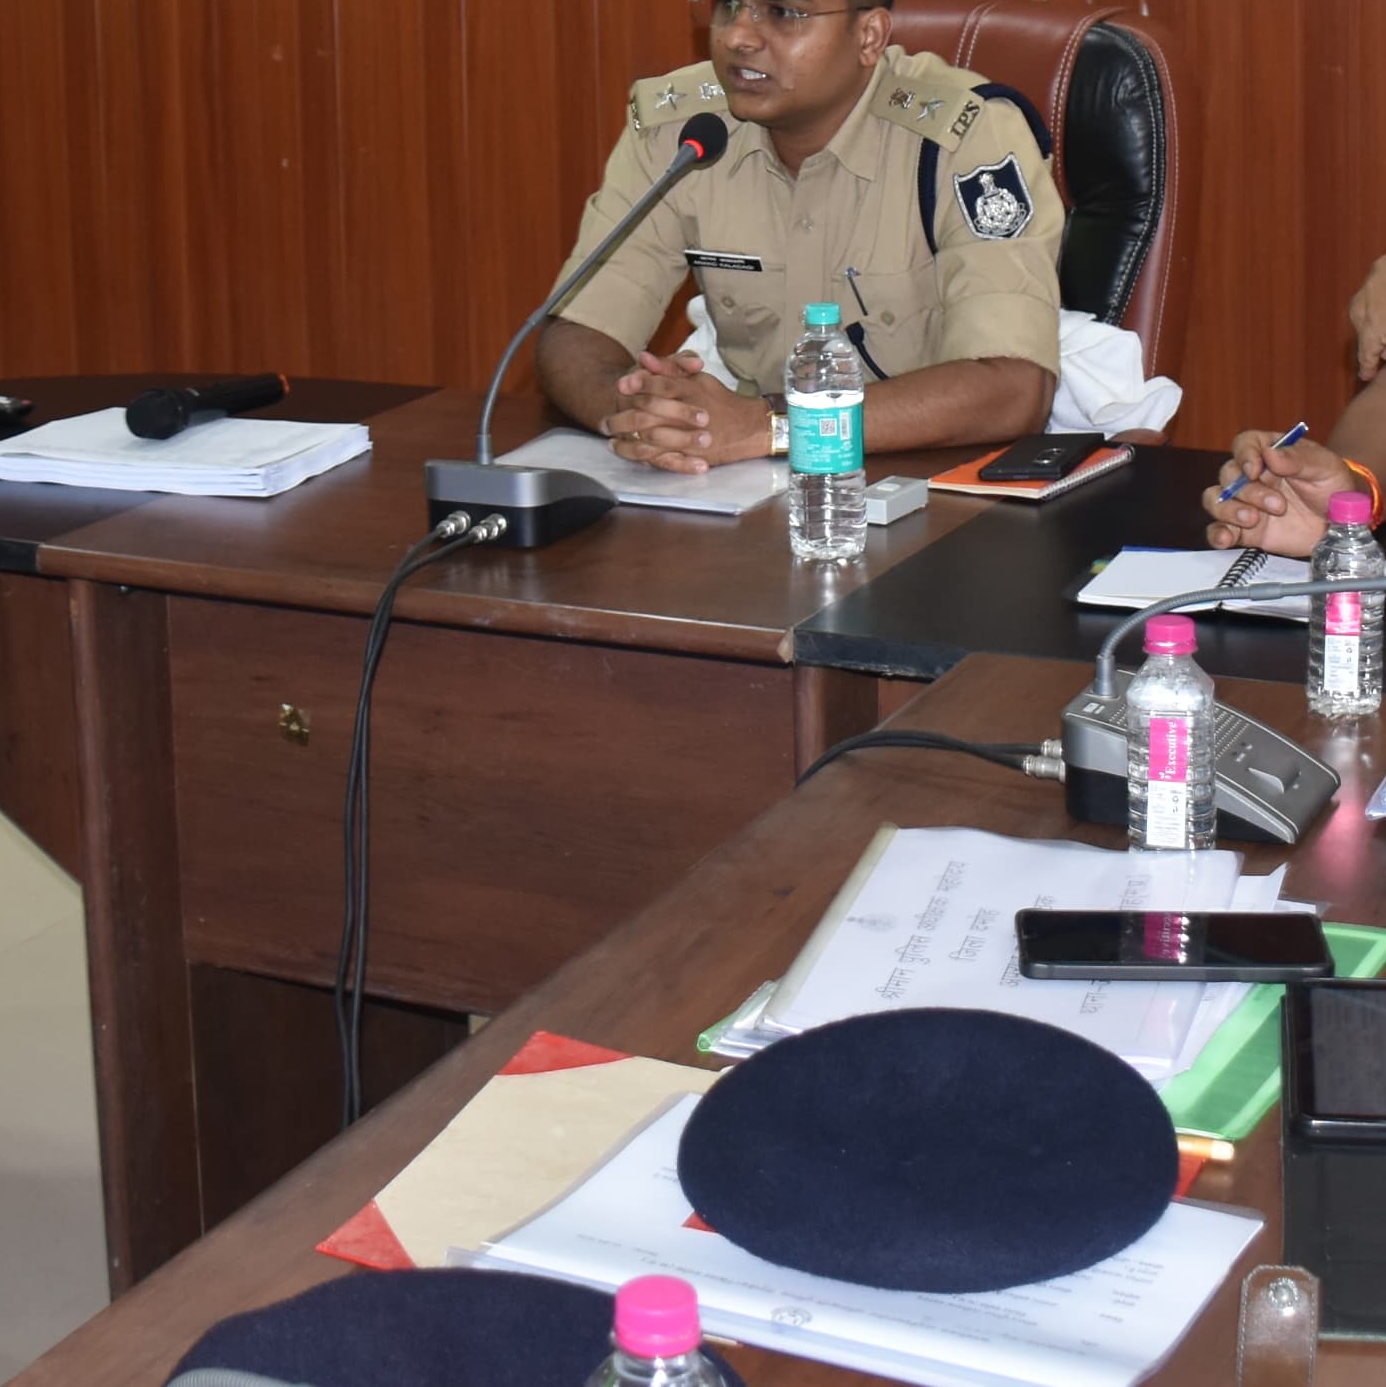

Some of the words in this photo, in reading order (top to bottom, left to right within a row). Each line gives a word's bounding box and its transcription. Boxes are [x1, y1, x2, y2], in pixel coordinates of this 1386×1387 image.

[1165, 721, 1178, 775] Executive
[895, 934, 932, 965] पुलिस
[949, 934, 986, 963] जिला
